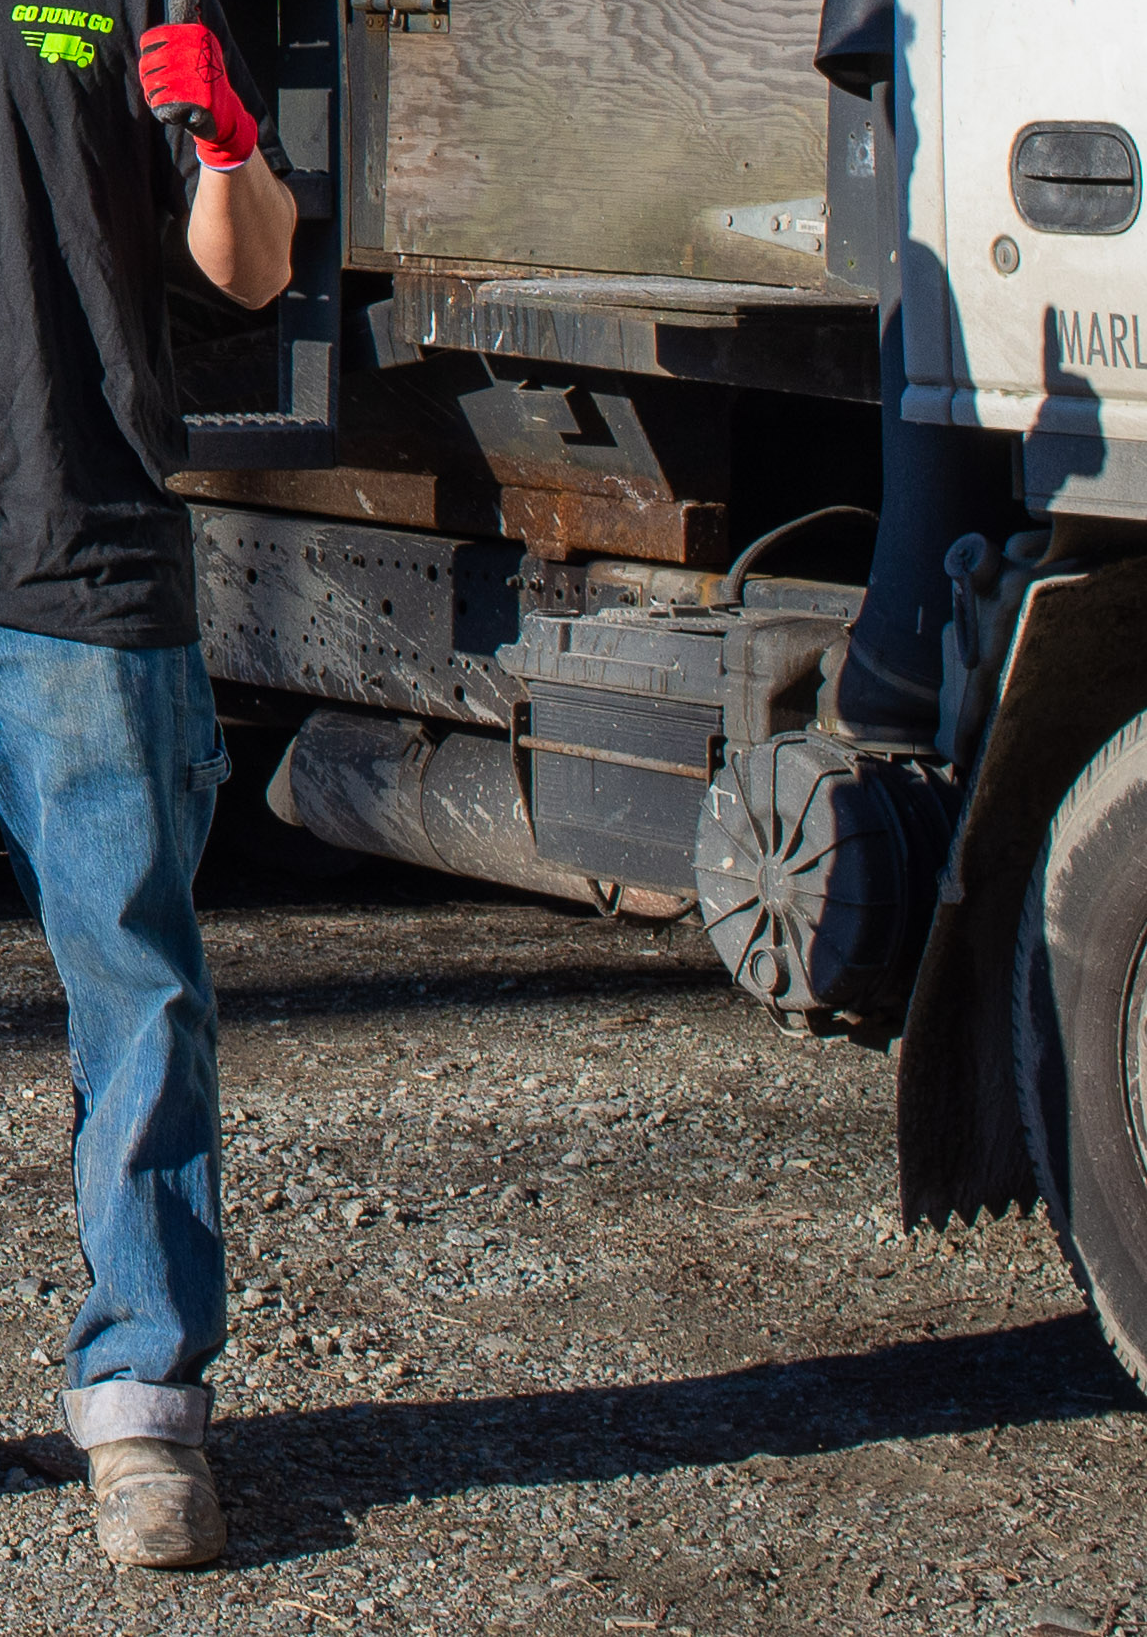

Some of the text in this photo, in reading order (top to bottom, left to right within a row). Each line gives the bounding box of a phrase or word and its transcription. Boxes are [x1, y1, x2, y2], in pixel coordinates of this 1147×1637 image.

[12, 5, 114, 34] GO JUNK GO
